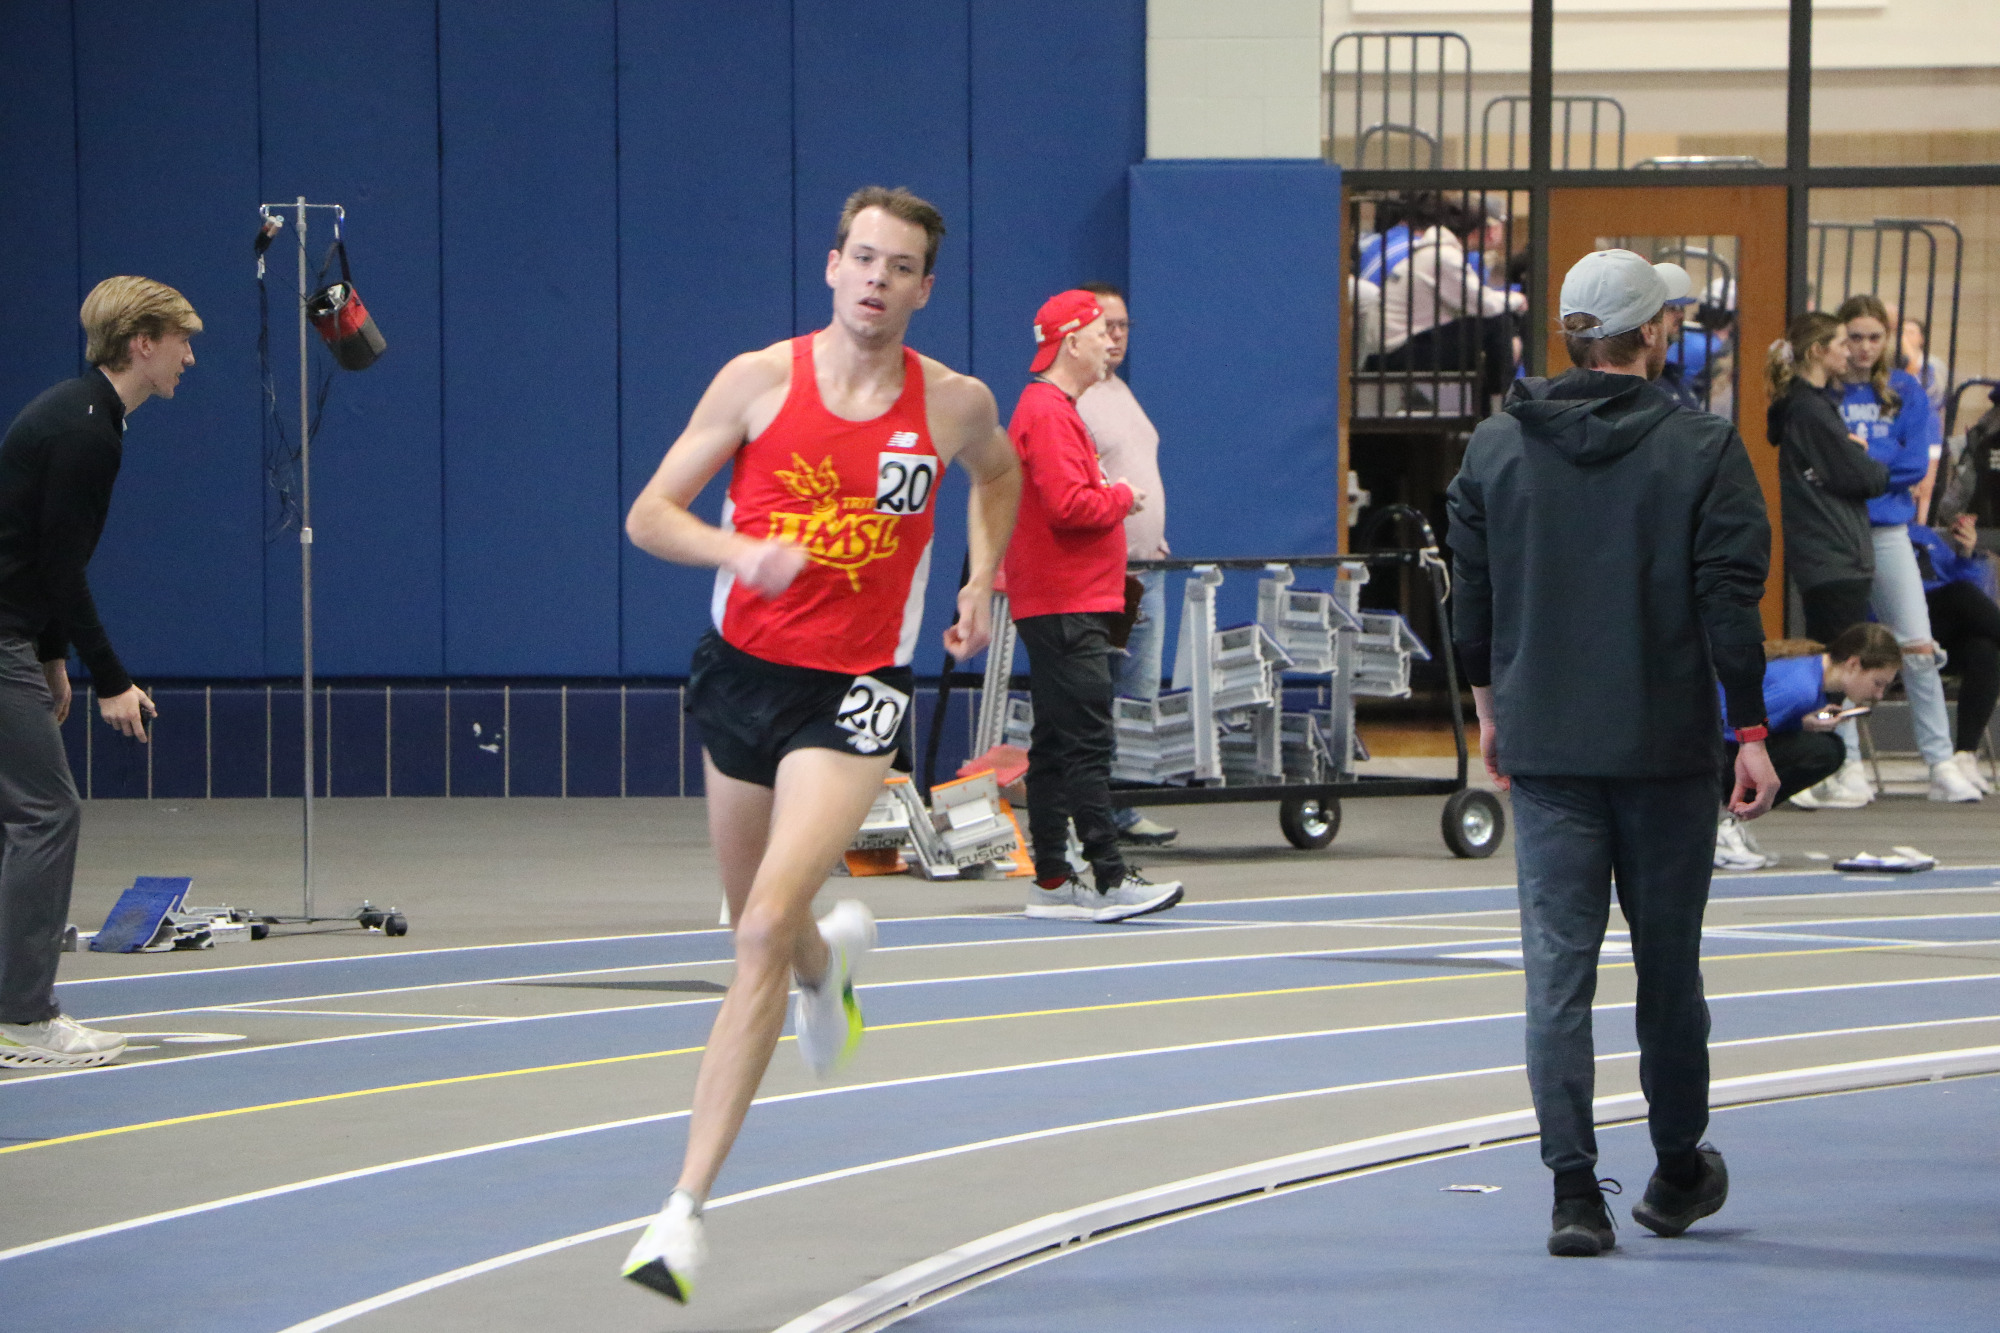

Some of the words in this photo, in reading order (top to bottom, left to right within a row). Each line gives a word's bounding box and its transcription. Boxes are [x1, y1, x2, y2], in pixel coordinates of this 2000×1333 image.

[877, 461, 932, 512] 20
[837, 684, 899, 740] 20
[957, 841, 1018, 867] FUSION
